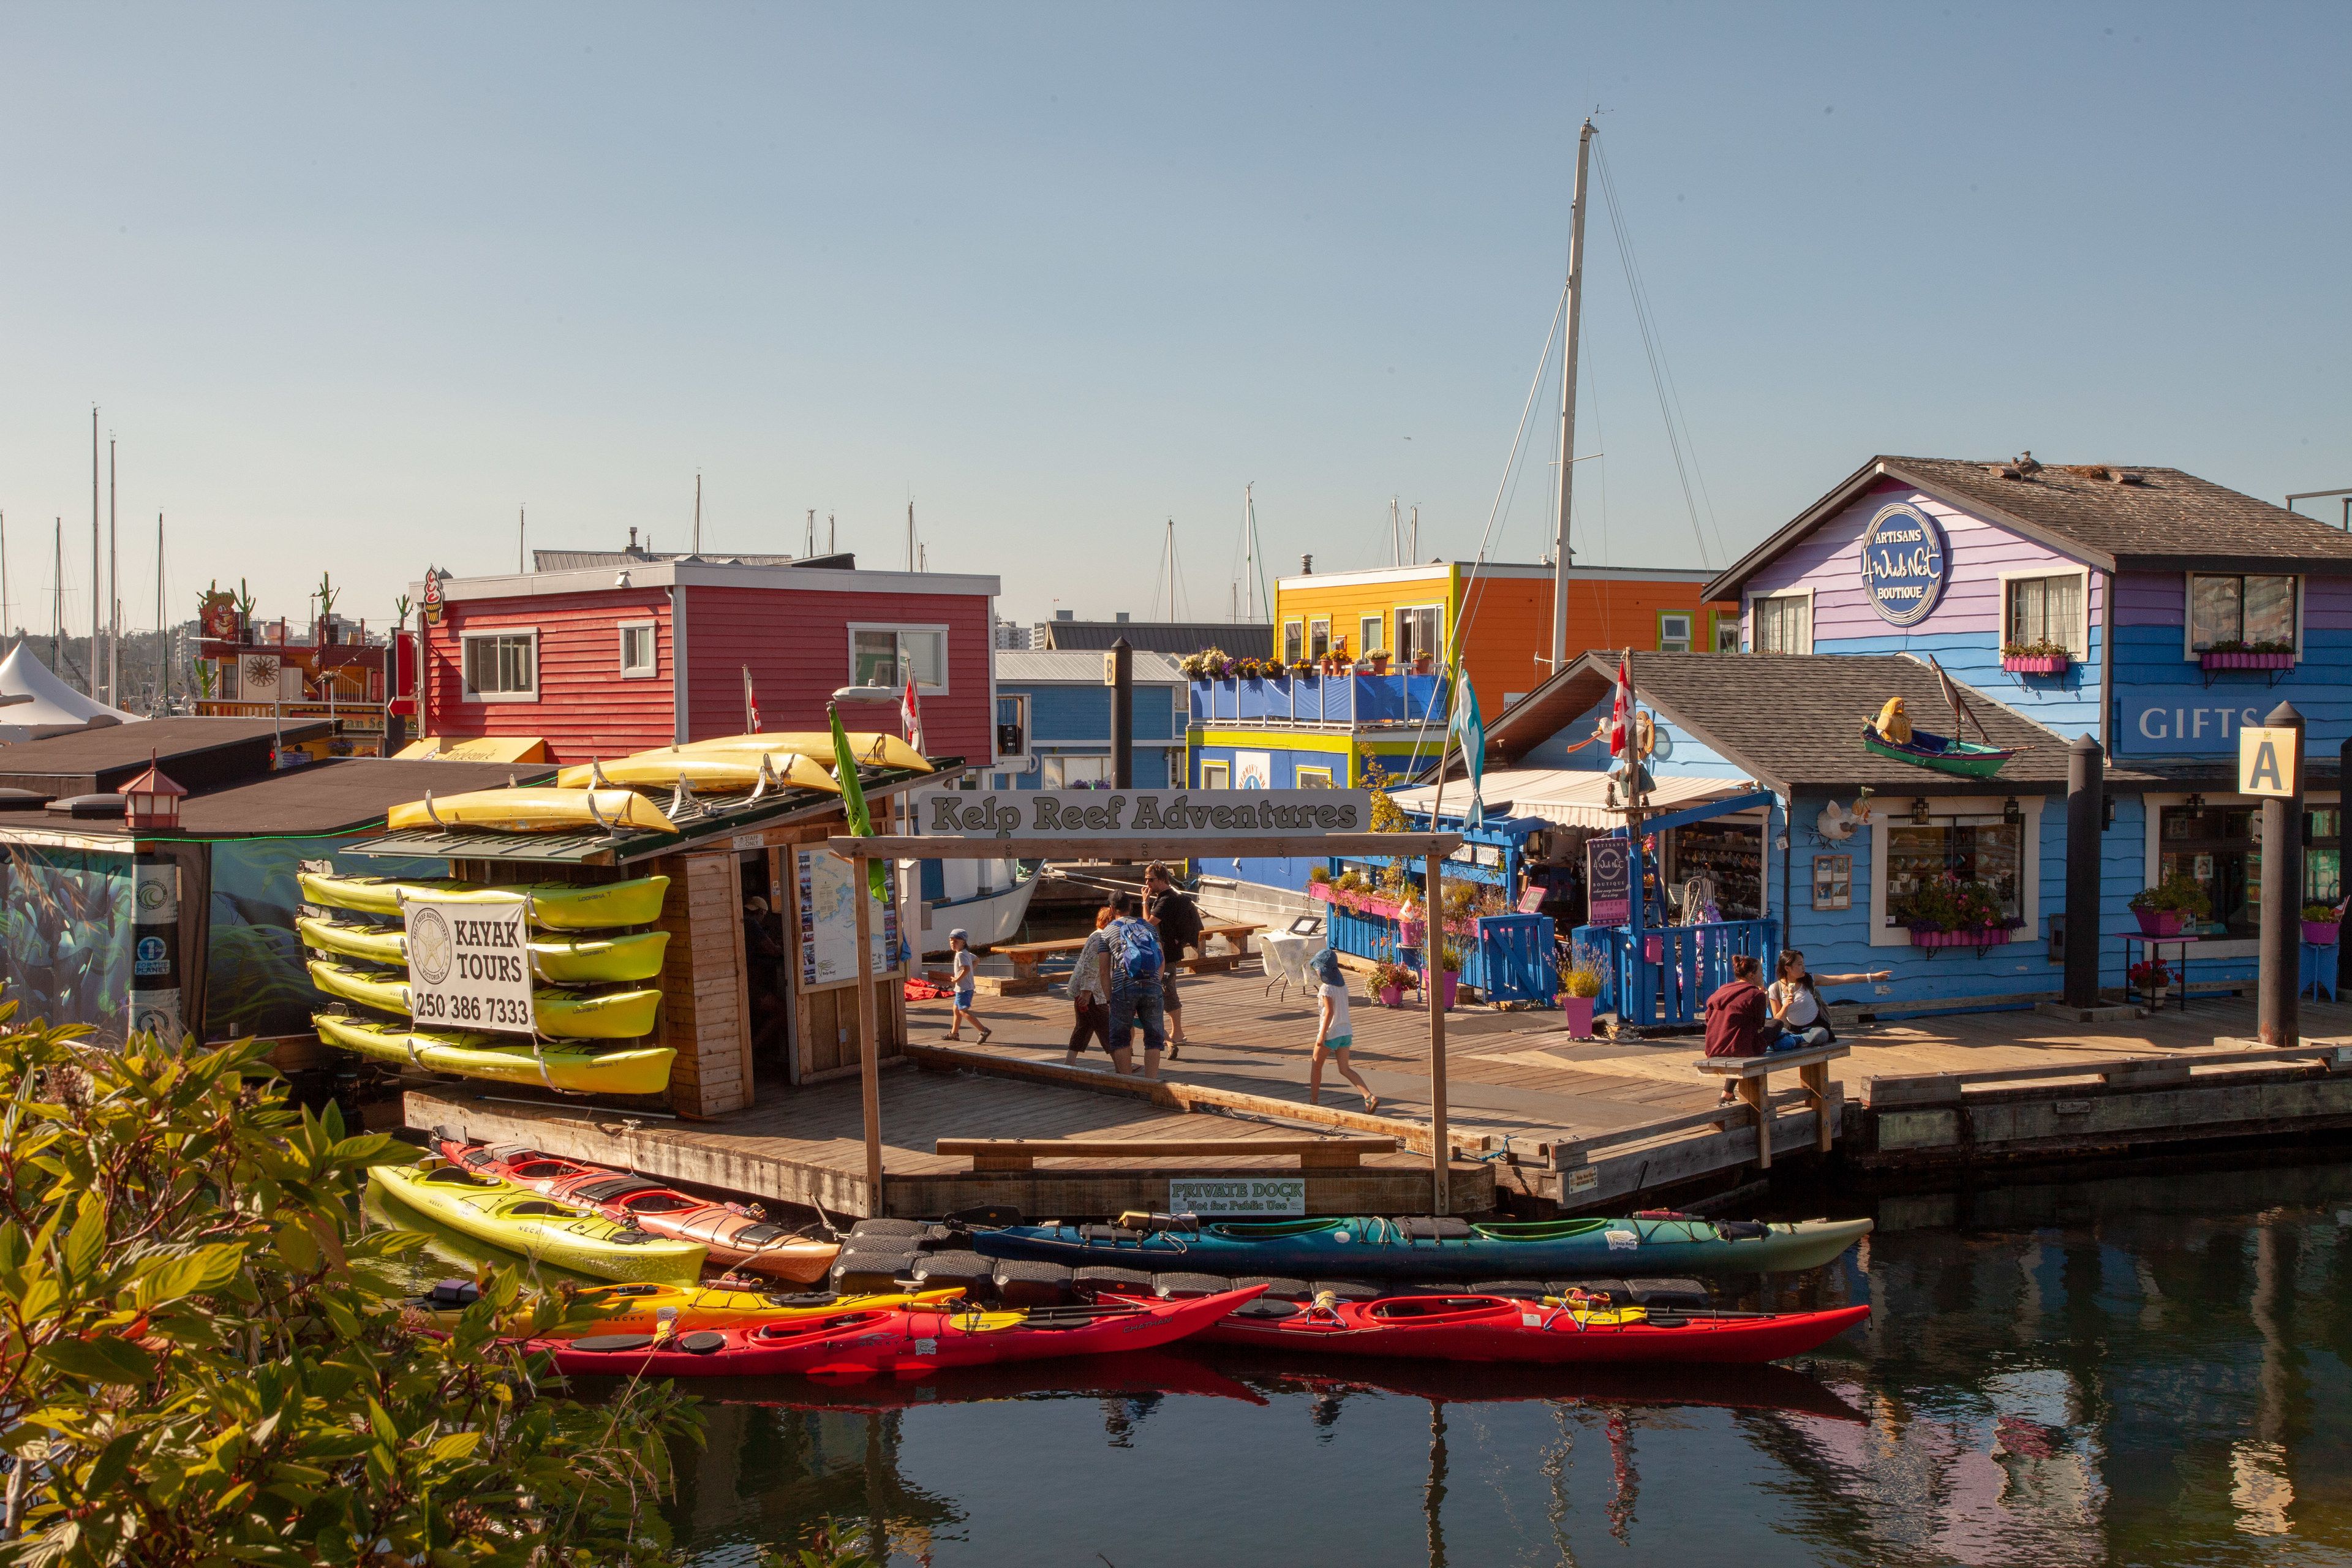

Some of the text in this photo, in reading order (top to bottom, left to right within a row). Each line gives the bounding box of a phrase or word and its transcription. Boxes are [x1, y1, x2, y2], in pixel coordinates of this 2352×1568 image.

[1875, 529, 1922, 545] ARTISANS
[1861, 546, 1941, 583] 4 Winds Nest
[1877, 586, 1923, 600] BOUTIQUE
[1107, 659, 1113, 682] B
[2139, 707, 2259, 739] GIFTS
[2249, 742, 2282, 790] A
[932, 795, 1357, 839] Kelp Reef Adventures
[1477, 847, 1498, 862] Pottery
[1593, 859, 1597, 870] 4
[417, 913, 426, 924] REEF
[426, 912, 448, 941] ADVENTURES
[454, 921, 519, 948] KAYAK
[146, 941, 165, 959] 1%
[423, 968, 445, 980] VICTORIA BC
[457, 953, 522, 982] TOURS
[417, 993, 529, 1025] 250 386 7333
[1172, 1183, 1303, 1197] PRIVATE DOCK
[1187, 1200, 1287, 1211] Not for Public Use
[518, 1226, 545, 1236] NECKY
[1123, 1316, 1172, 1333] CHATHAM
